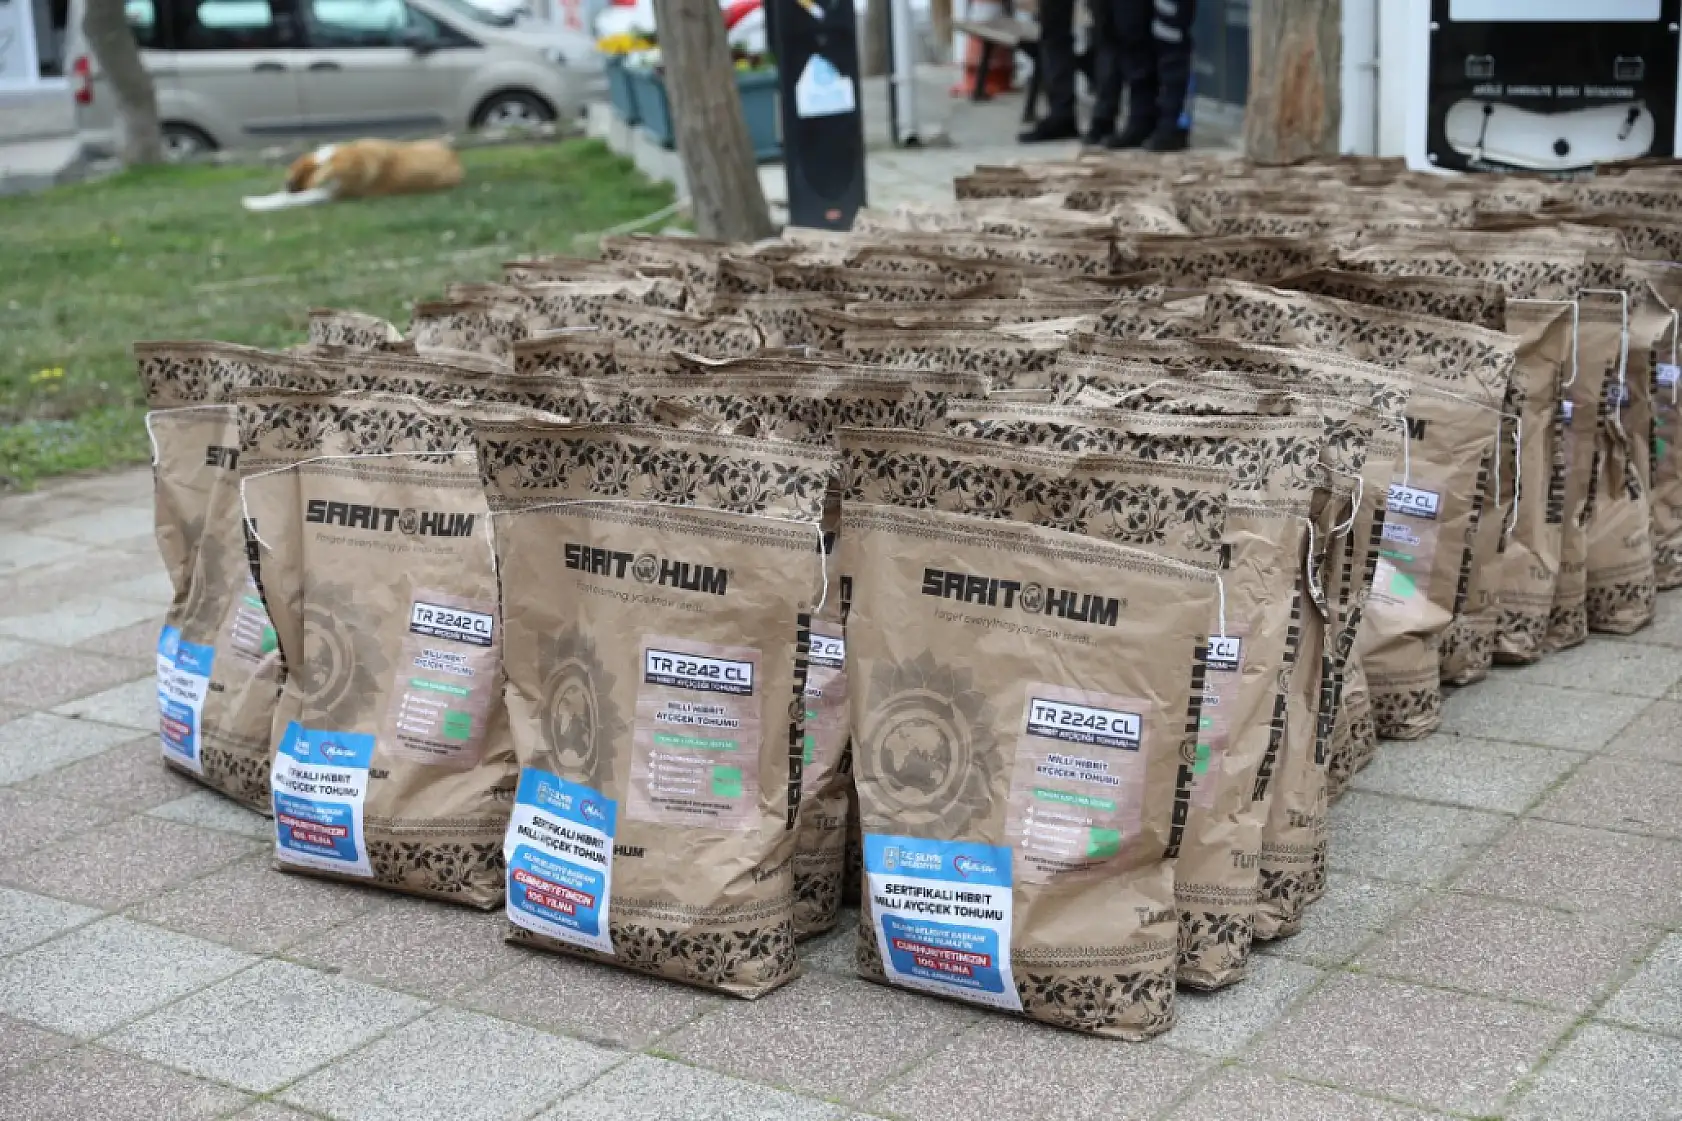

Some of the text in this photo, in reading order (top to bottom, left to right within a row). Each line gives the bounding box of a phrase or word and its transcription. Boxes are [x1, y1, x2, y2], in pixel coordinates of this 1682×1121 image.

[417, 608, 488, 633] TR 2242 CL
[652, 657, 748, 682] TR 2242 CL
[1035, 706, 1136, 735] TR 2242 CL
[953, 906, 1003, 921] TOHUMU
